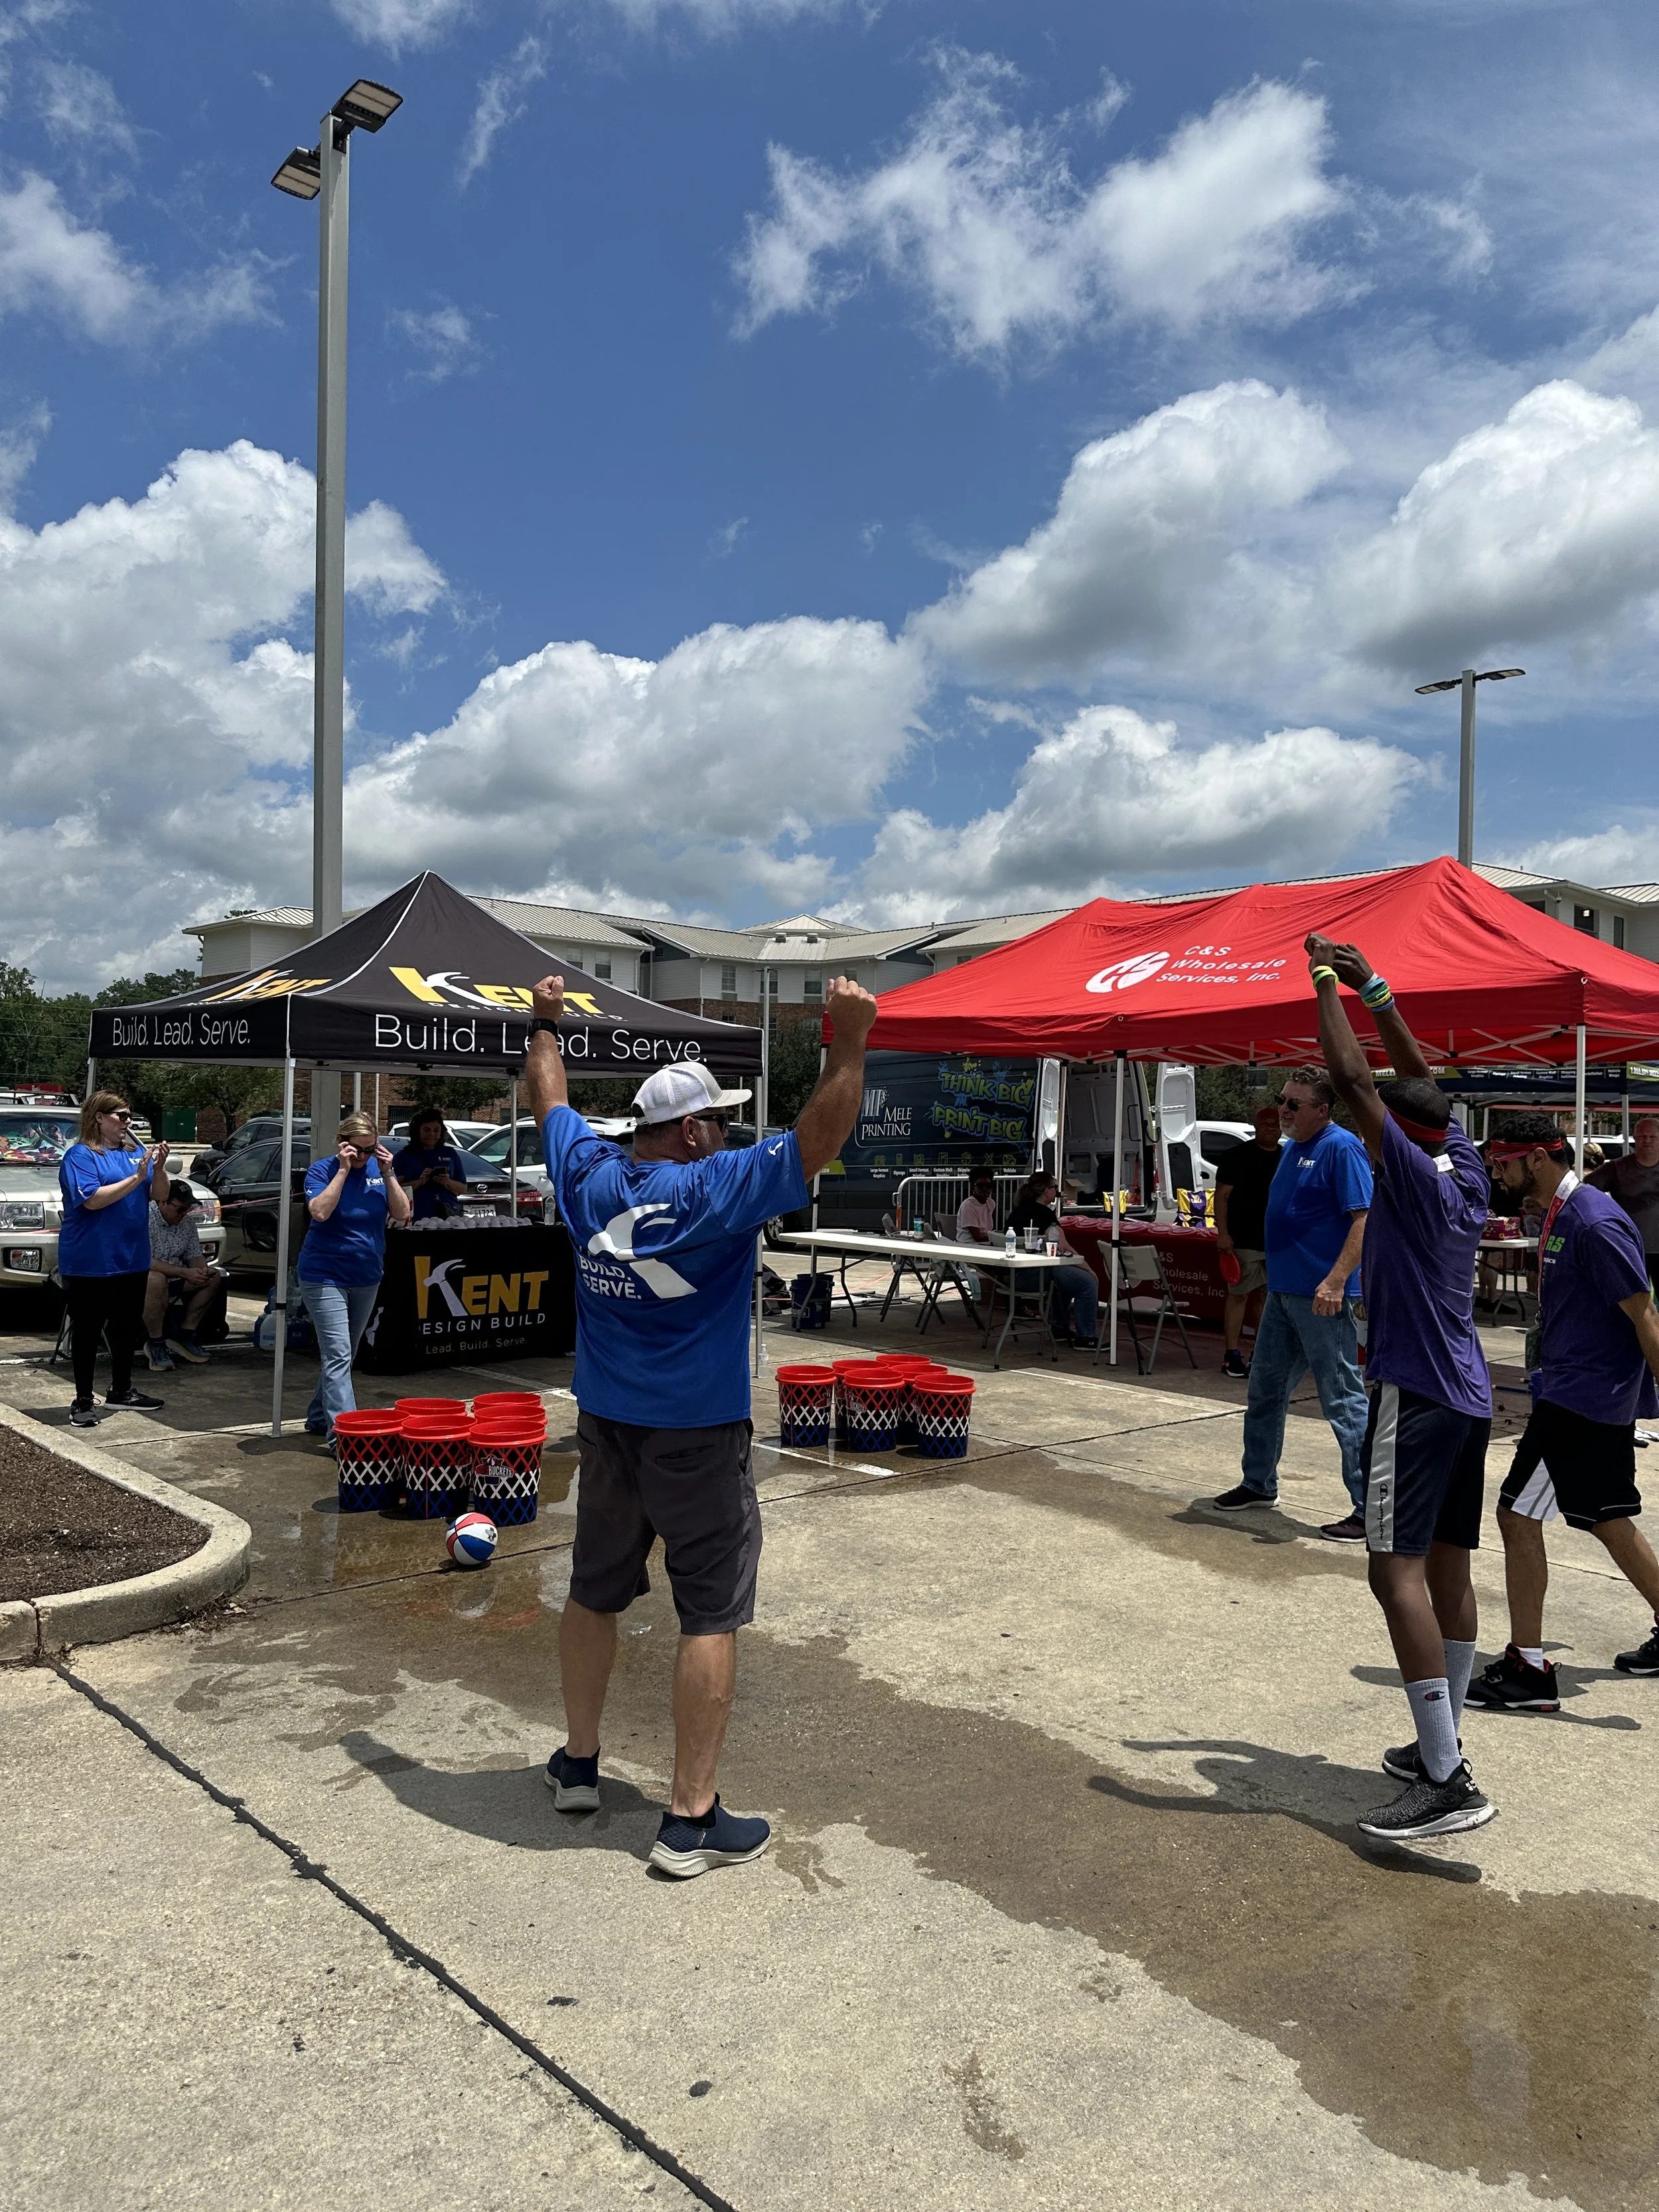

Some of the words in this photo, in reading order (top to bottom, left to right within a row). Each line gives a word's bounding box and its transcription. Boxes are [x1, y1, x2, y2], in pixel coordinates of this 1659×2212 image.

[1185, 946, 1232, 956] C&S
[1170, 959, 1287, 970] Wholesale
[1156, 973, 1240, 984] Services,
[1246, 972, 1281, 982] Inc.
[561, 1012, 624, 1021] UILD
[113, 1015, 149, 1046] Build.
[154, 1013, 194, 1046] Lead.
[200, 1013, 250, 1045] Serve.
[376, 1014, 484, 1053] Build.
[611, 1029, 707, 1062] Serve.
[940, 1072, 994, 1098] THINK
[997, 1079, 1035, 1107] BIG
[884, 1106, 912, 1122] MELE
[861, 1122, 911, 1140] PRINTING
[989, 1118, 1024, 1142] BIG
[1297, 1157, 1316, 1166] KENT
[1158, 1252, 1173, 1262] &S
[1163, 1266, 1208, 1281] holesale
[414, 1256, 549, 1319] KENT
[583, 1273, 642, 1299] SERVE.
[419, 1319, 482, 1335] ESIGN
[491, 1313, 546, 1329] BUILD
[426, 1343, 455, 1355] Lead.
[460, 1339, 491, 1351] Build.
[496, 1335, 528, 1348] Serve.
[488, 1465, 512, 1476] BUCKETS
